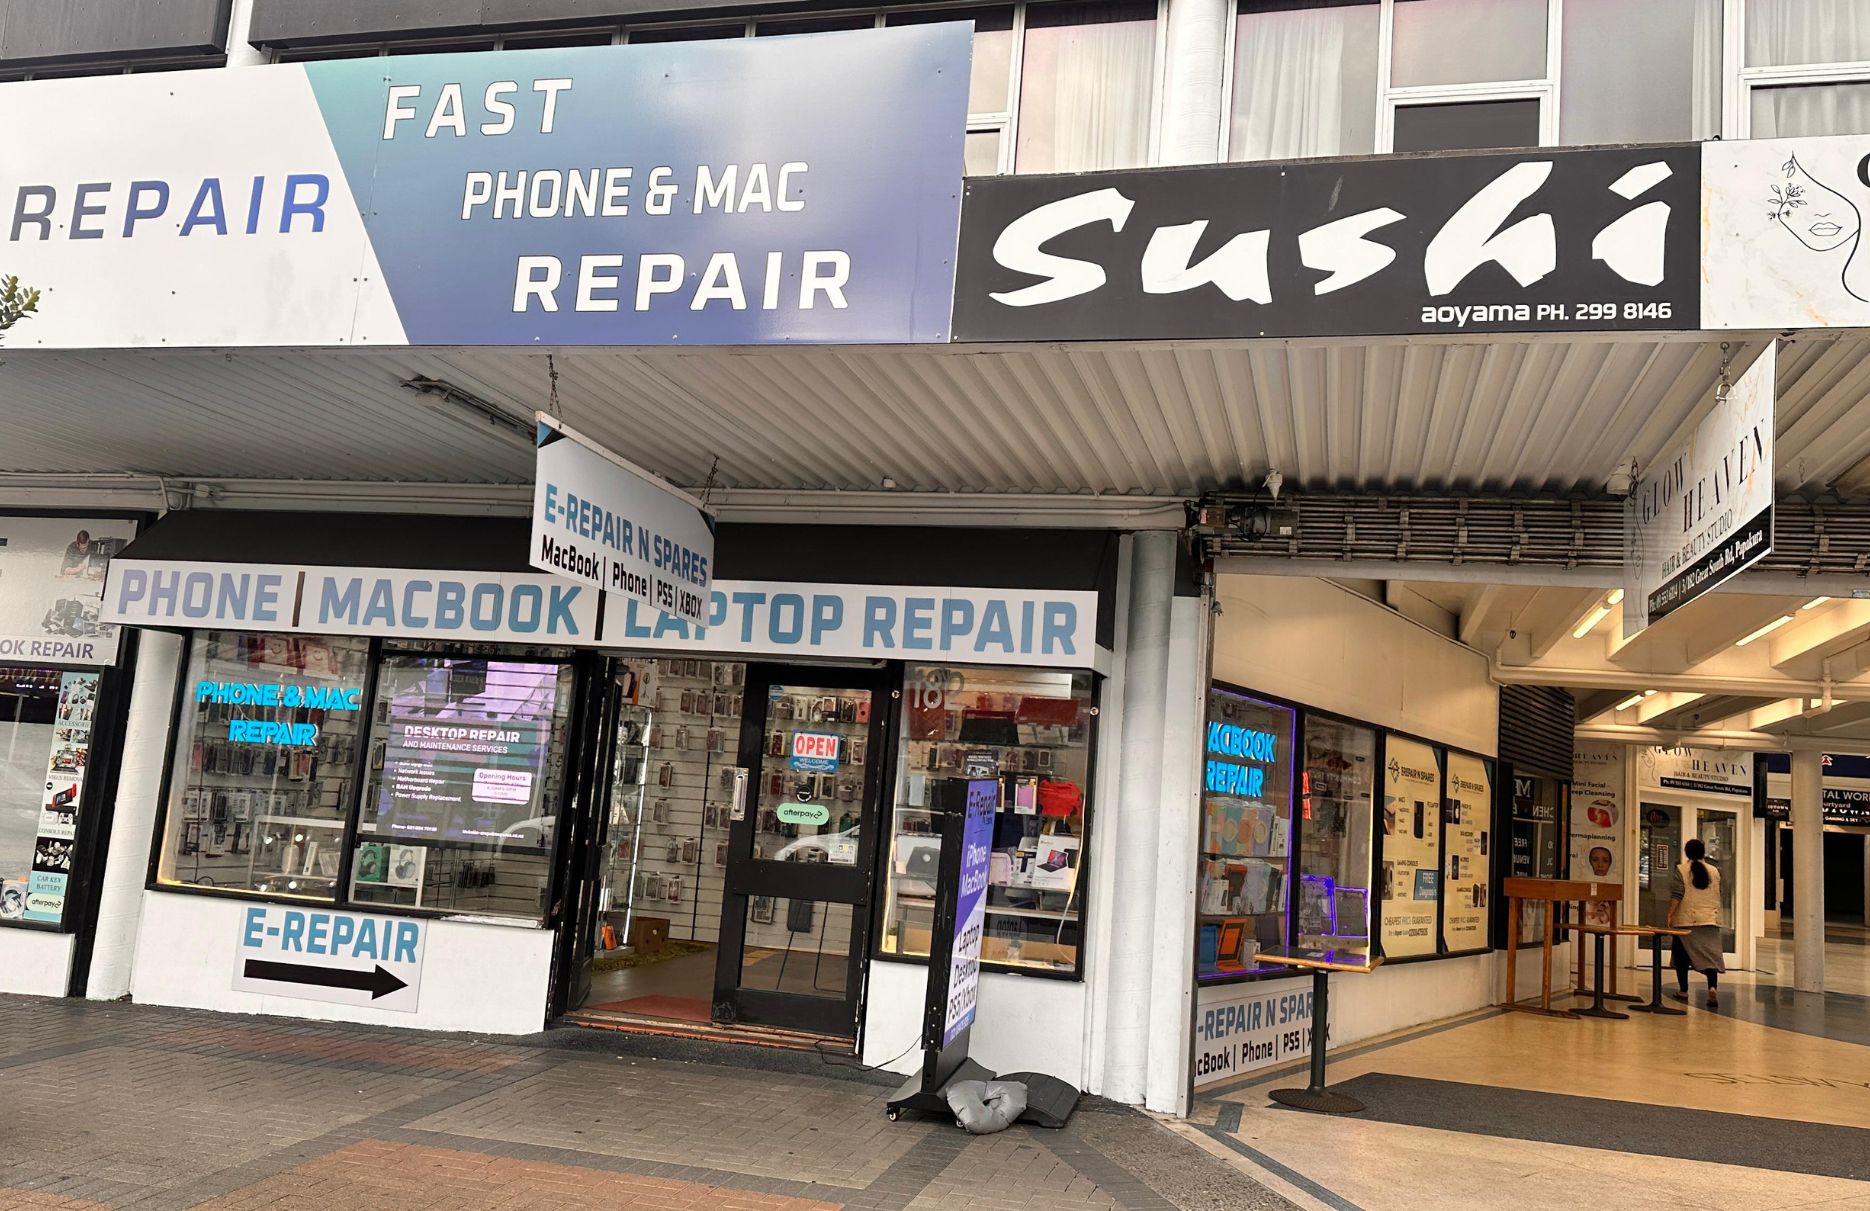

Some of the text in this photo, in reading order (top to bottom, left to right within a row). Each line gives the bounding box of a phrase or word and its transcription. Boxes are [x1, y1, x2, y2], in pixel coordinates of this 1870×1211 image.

[382, 77, 573, 140] FAST
[460, 161, 809, 220] PHONE & MAC
[9, 173, 330, 241] REPAIR
[988, 161, 1674, 307] Sushi
[512, 249, 851, 312] REPAIR
[1421, 302, 1672, 327] aoyama PH. 299 8146
[1643, 452, 1687, 524] GLOW
[1683, 418, 1765, 533] HEAVEN
[544, 483, 707, 588] E-REPAIR N SPARES
[541, 534, 702, 620] MacBook Phone PS5 XBOX
[117, 569, 282, 622] PHONE
[318, 576, 582, 635] MACBOOK
[862, 595, 1077, 656] REPAIR
[30, 640, 94, 659] REPAIR
[195, 681, 362, 711] PHONE & MAC
[912, 667, 966, 711] 182
[228, 719, 318, 747] REPAIR
[402, 740, 508, 753] AND MAINTENANCE SERVICES
[404, 726, 521, 742] DESKTOP REPAIR
[795, 735, 837, 757] OPEN
[799, 757, 828, 765] WELCOME
[1692, 759, 1747, 776] HEAVEN
[479, 772, 506, 781] Opening
[1206, 759, 1264, 798] REPAIR
[1584, 789, 1616, 798] Cleansing
[783, 808, 815, 819] afterpay
[966, 842, 987, 868] iPhone
[36, 884, 62, 892] BATTERY
[961, 865, 988, 898] MacBook
[32, 898, 55, 909] afterpay
[243, 907, 419, 964] E-REPAIR
[958, 924, 980, 954] Laptop
[953, 957, 978, 988] Desktop
[1265, 998, 1276, 1027] N
[1242, 1041, 1272, 1064] Phone
